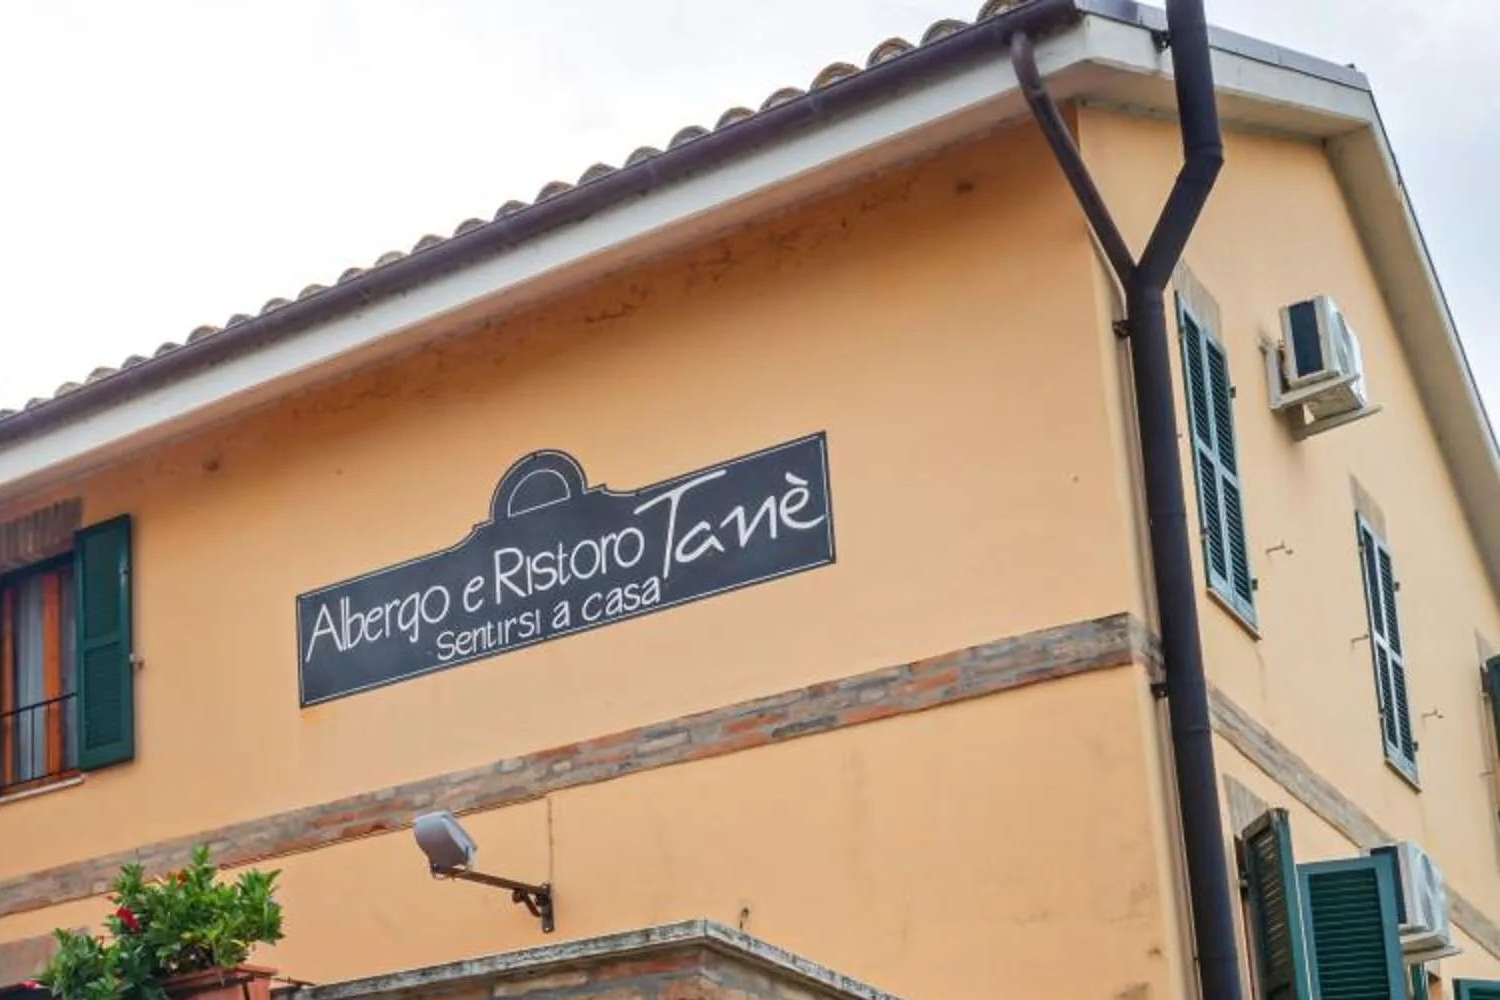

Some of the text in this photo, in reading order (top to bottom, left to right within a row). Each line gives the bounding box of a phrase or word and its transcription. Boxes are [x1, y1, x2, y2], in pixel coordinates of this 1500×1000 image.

[305, 584, 451, 662] Albergo
[462, 575, 484, 613] e
[634, 470, 825, 580] Tanè
[551, 601, 572, 629] a
[580, 576, 661, 623] casa
